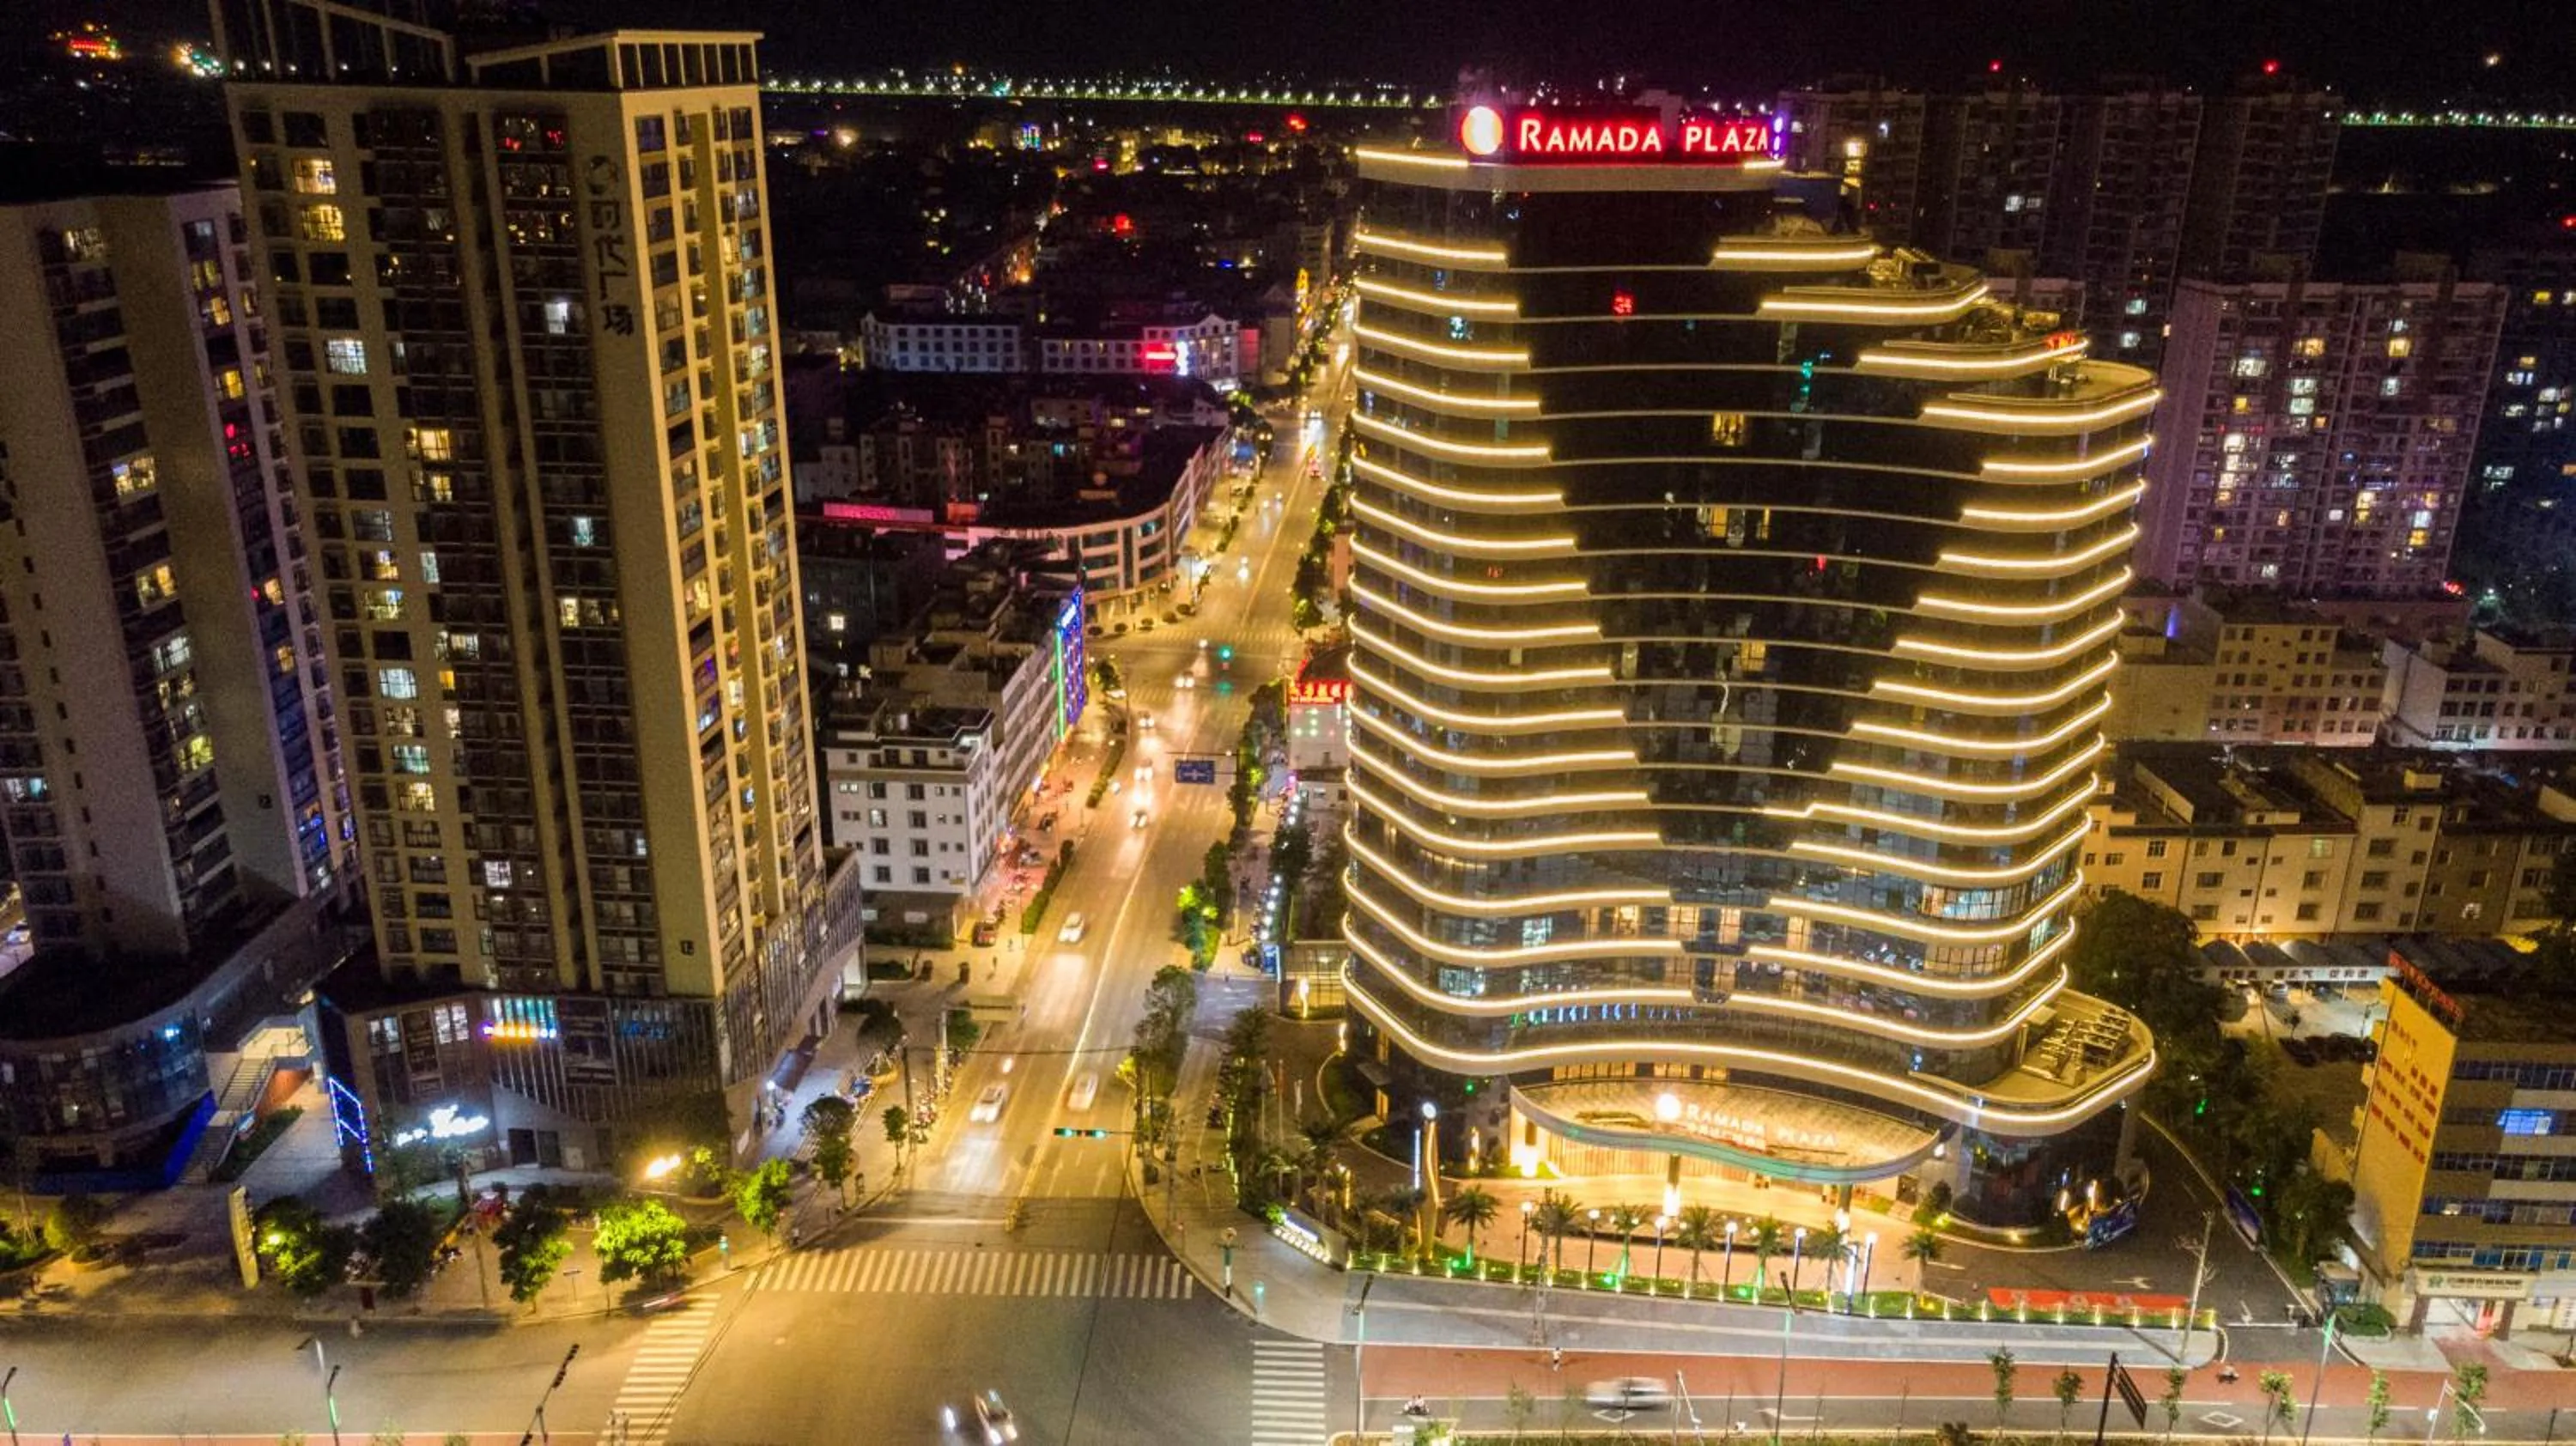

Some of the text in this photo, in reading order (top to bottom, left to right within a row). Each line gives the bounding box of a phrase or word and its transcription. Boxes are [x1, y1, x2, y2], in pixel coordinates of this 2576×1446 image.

[1520, 118, 1769, 152] RAMADA PLAZA
[1686, 1103, 1765, 1134] RAMADA
[1777, 1127, 1838, 1147] PLAZA
